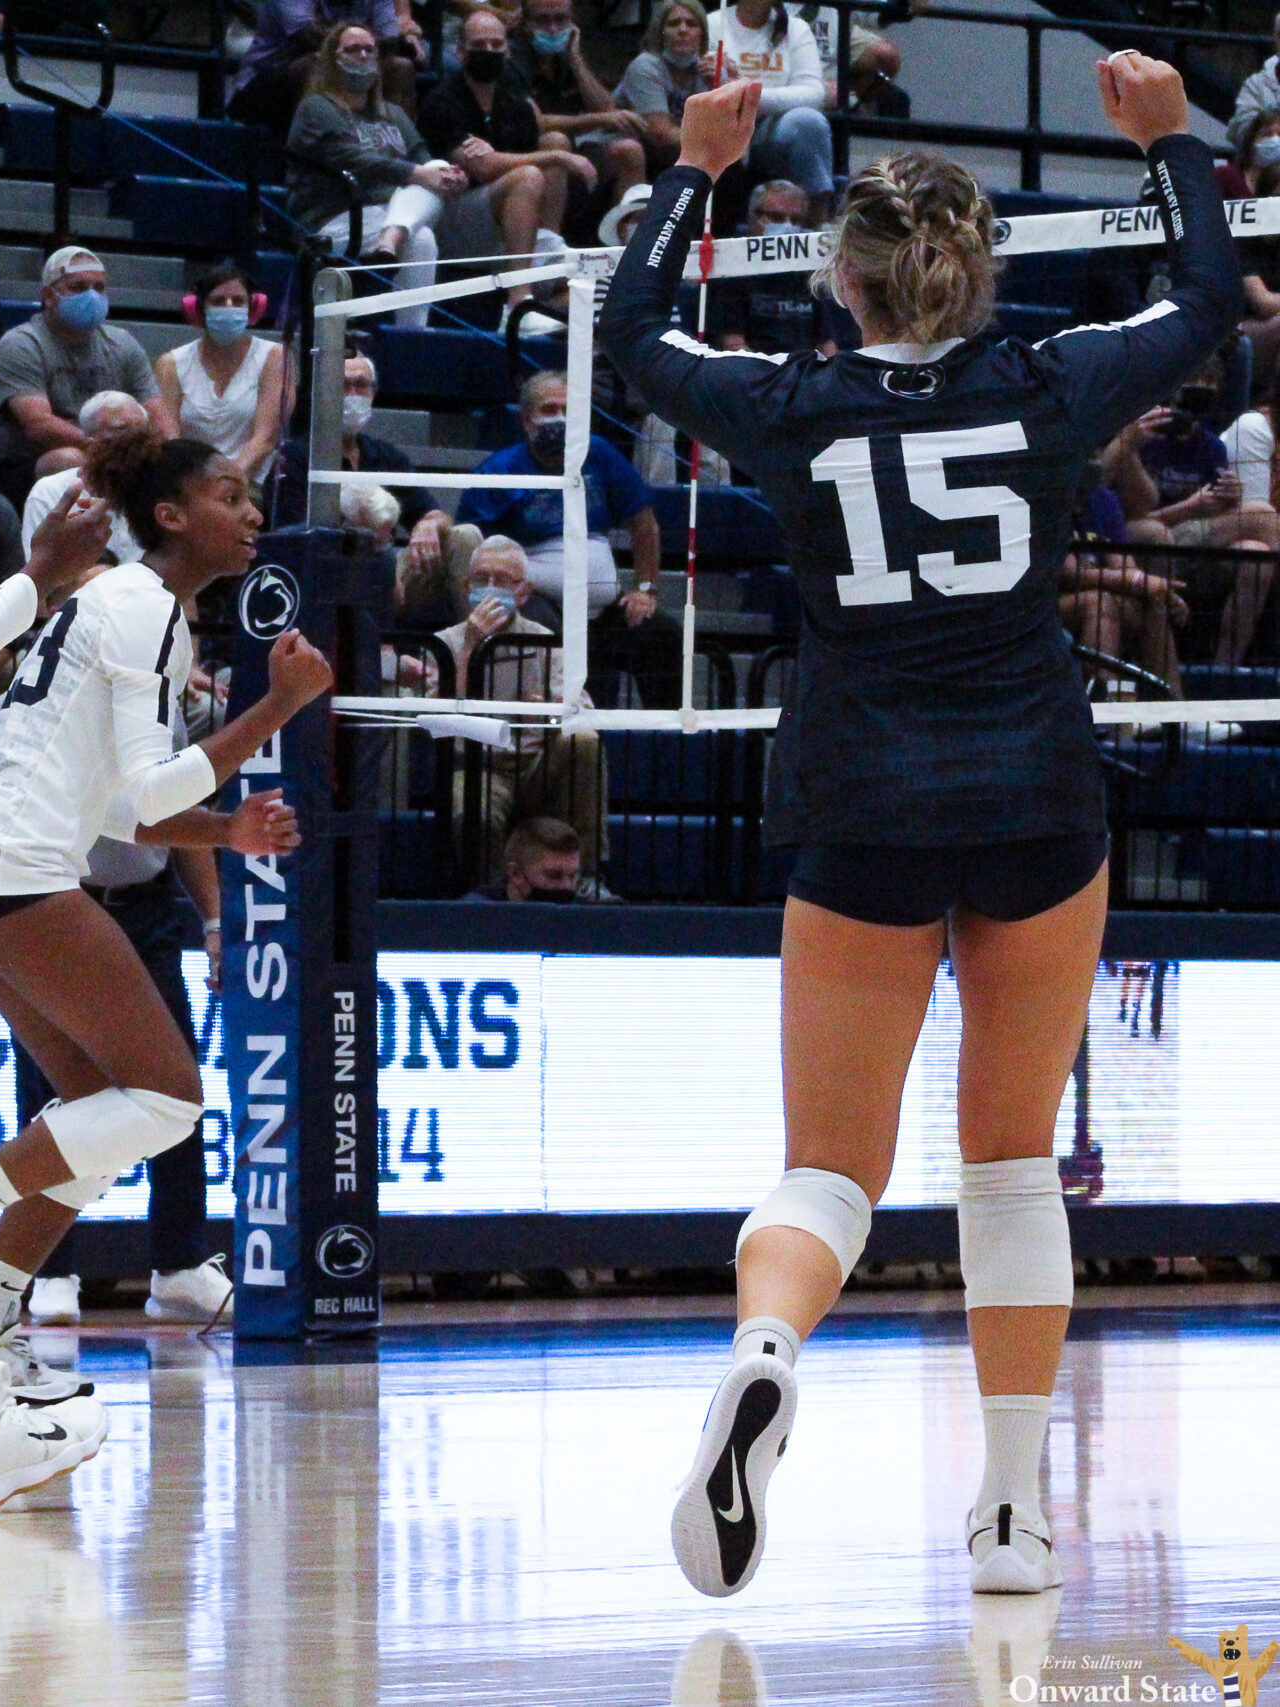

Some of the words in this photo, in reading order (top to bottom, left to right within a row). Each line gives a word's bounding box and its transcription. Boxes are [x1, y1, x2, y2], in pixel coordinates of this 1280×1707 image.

[740, 52, 784, 72] SU
[1156, 159, 1179, 211] NITTANY
[647, 219, 677, 269] NITTANY
[674, 187, 695, 222] LIONS
[747, 235, 809, 262] PENN
[810, 420, 1032, 606] 15
[332, 990, 357, 1083] PENN
[243, 1034, 288, 1288] PENN
[333, 1092, 358, 1194] STATE
[314, 1298, 340, 1315] REC
[343, 1296, 376, 1313] HALL
